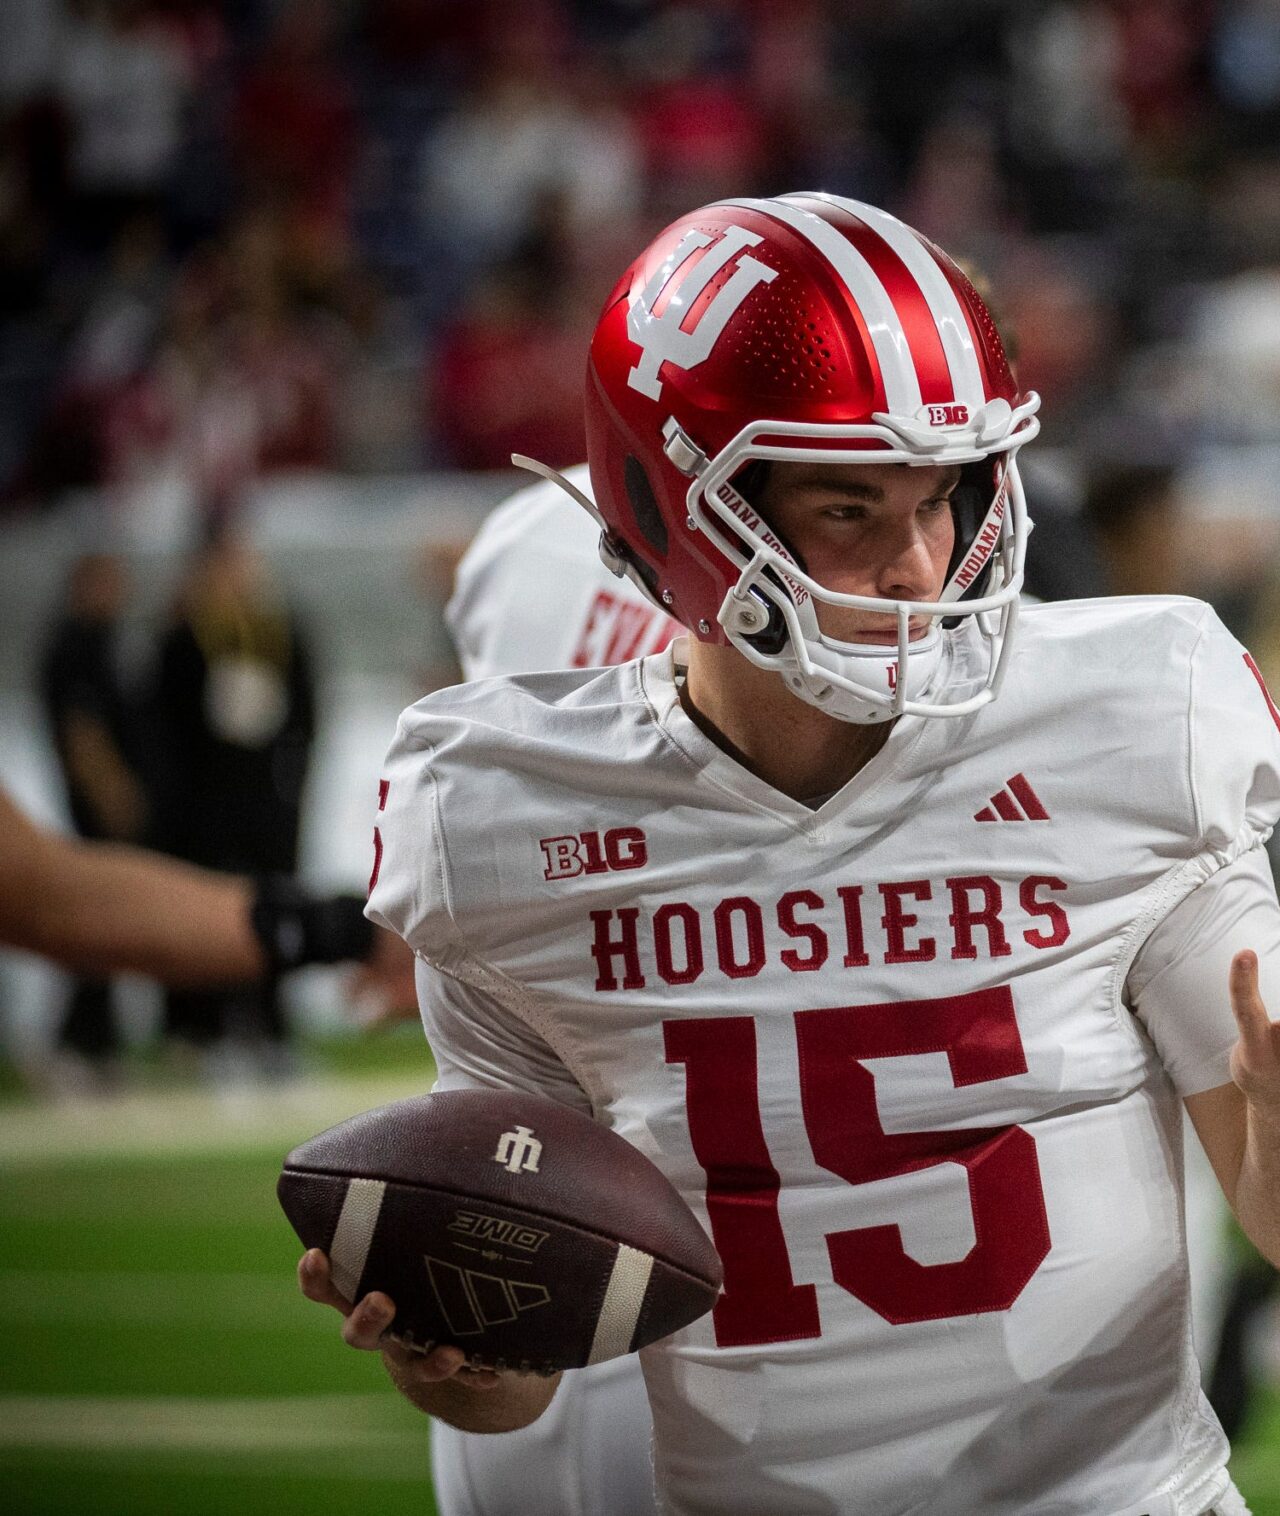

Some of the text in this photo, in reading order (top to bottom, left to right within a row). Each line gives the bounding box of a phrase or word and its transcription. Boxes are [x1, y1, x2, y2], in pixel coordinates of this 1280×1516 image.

[716, 484, 761, 532] DIANA
[954, 521, 1000, 590] INDIANA
[590, 875, 1070, 991] HOOSIERS
[663, 985, 1051, 1348] 15
[447, 1209, 551, 1253] DIME
